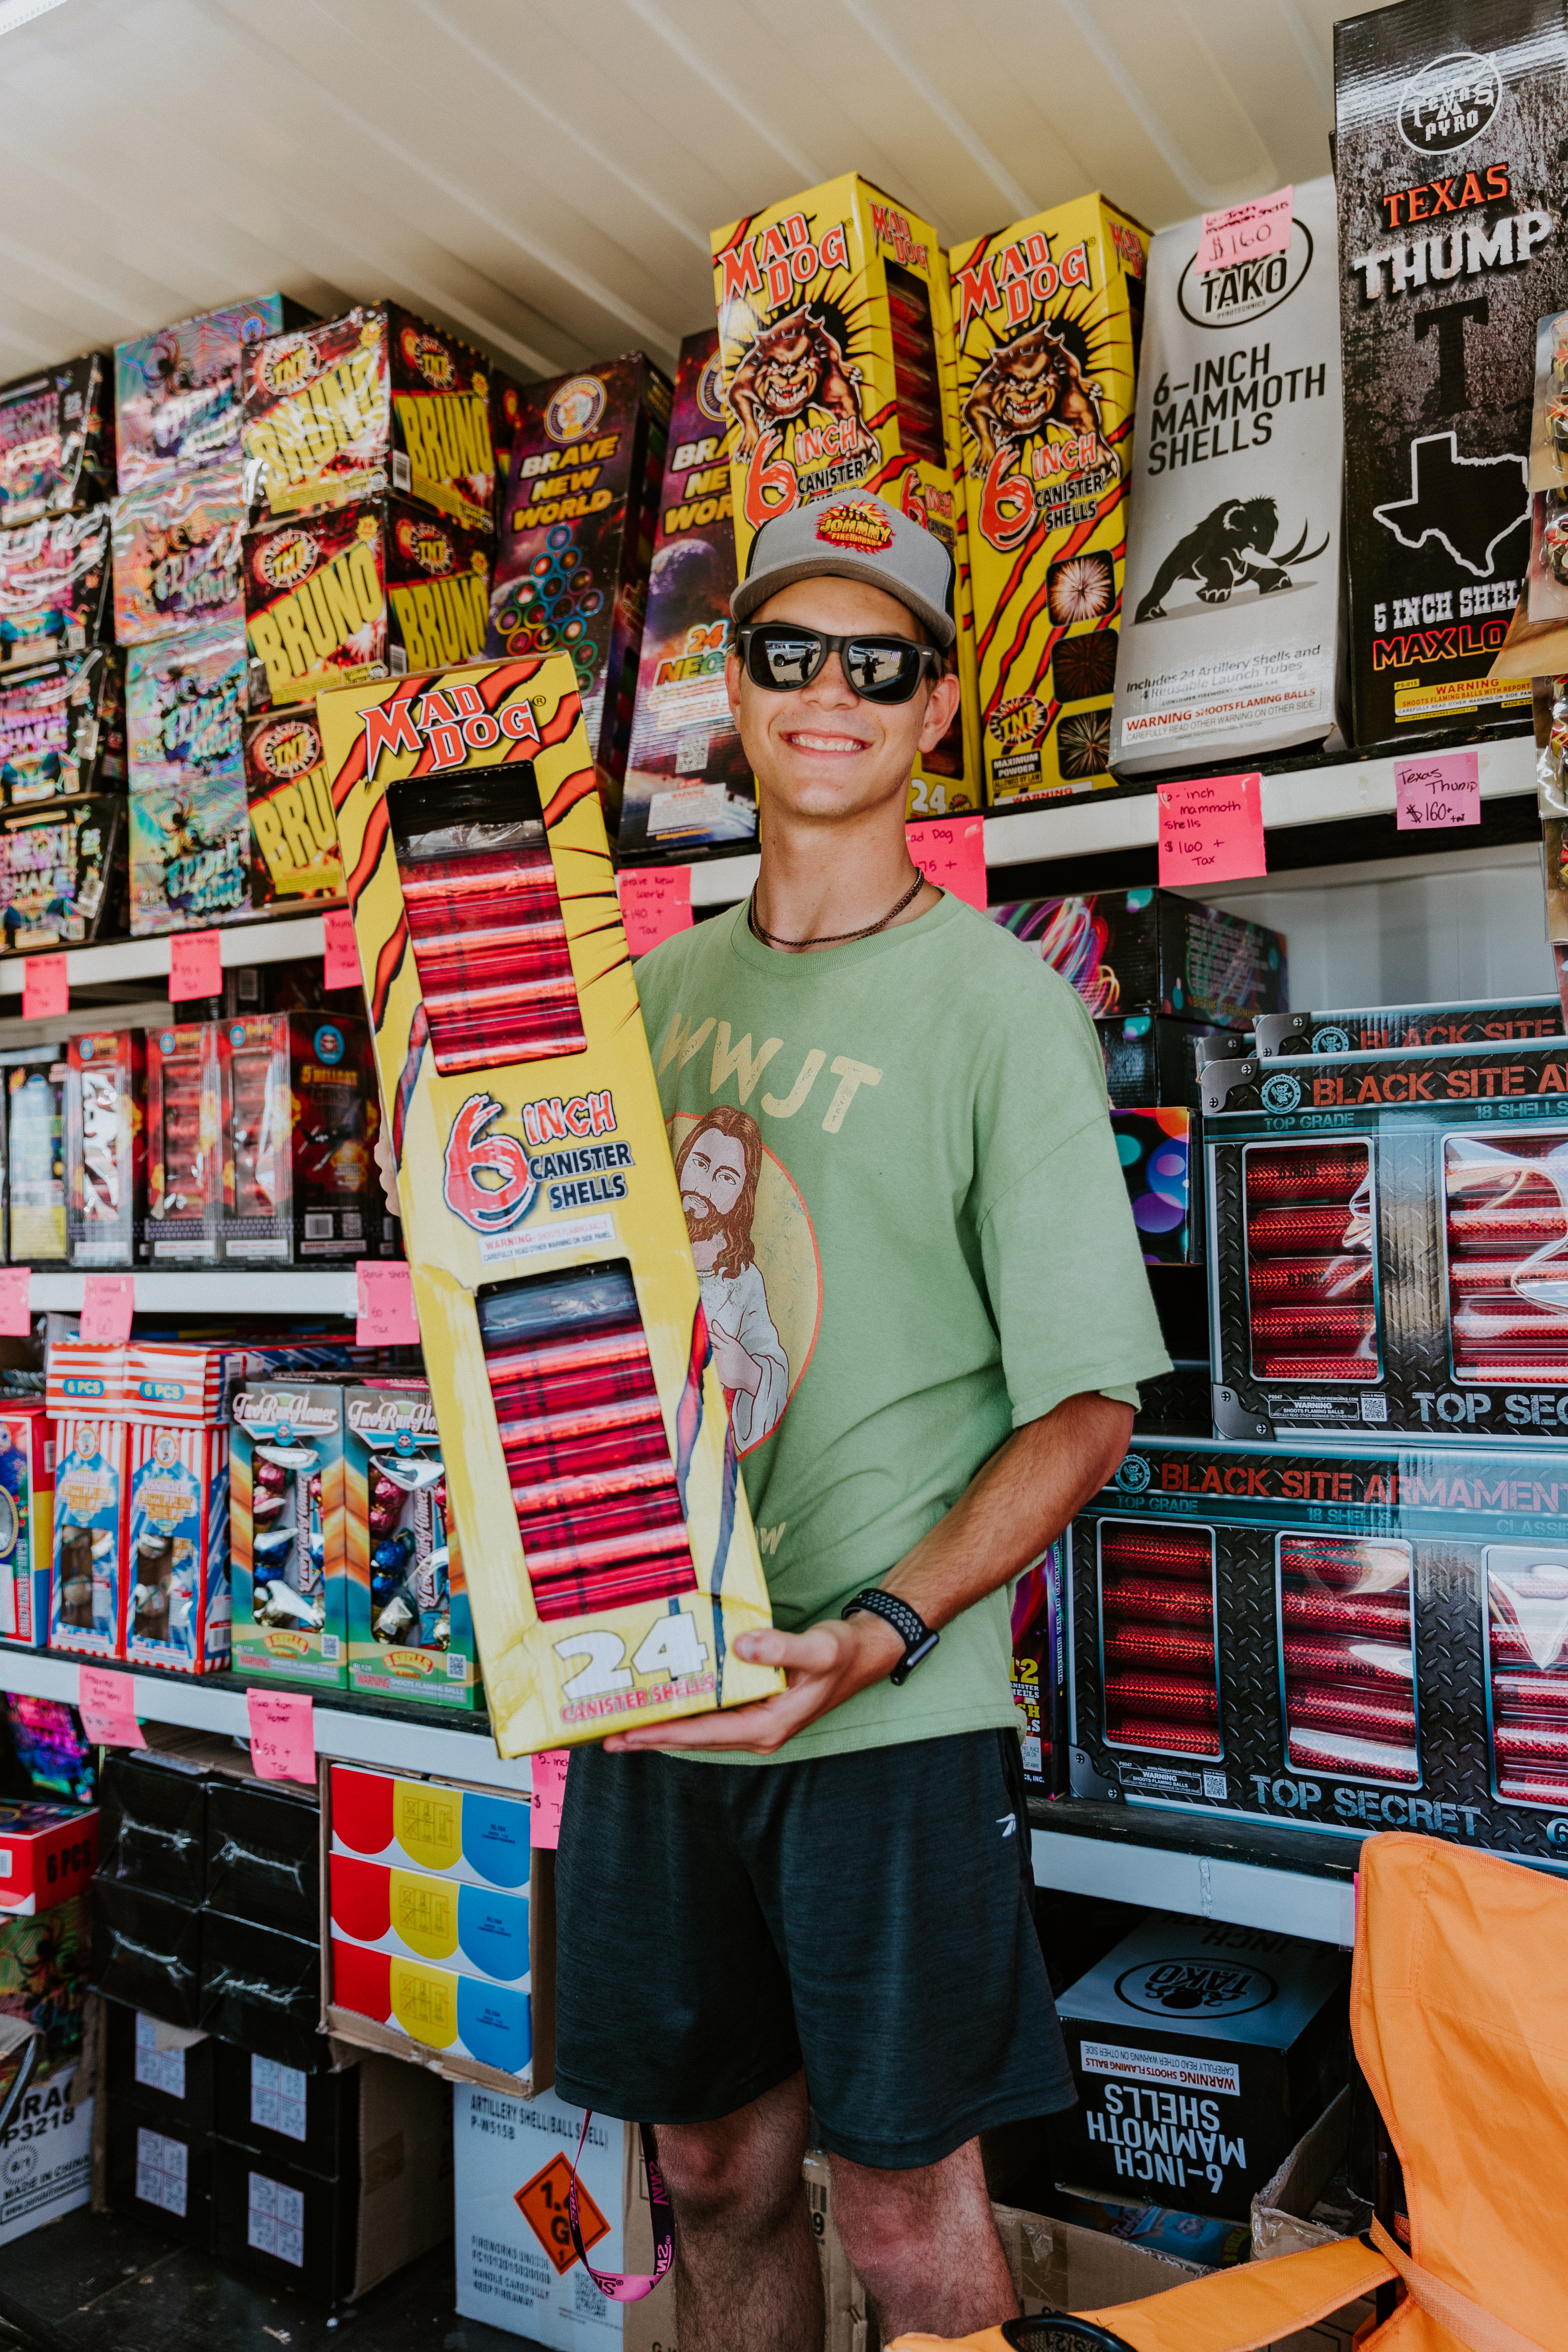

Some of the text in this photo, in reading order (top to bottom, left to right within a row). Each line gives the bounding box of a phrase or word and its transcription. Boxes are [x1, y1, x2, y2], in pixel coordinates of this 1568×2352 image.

[1384, 164, 1508, 227] TEXAS
[868, 199, 911, 255] MAD
[718, 211, 809, 336] MAD
[765, 223, 851, 313] DOG
[892, 234, 930, 279] DOG
[1353, 211, 1553, 299] THUMP
[956, 231, 1050, 355] MAD
[1004, 241, 1090, 331] DOG
[1201, 257, 1287, 313] TAKO
[272, 346, 307, 387] TNT
[422, 351, 449, 374] TNT
[1152, 343, 1271, 406] 6-INCH
[1150, 363, 1326, 442] MAMMOTH
[244, 349, 382, 515] BRUNO
[393, 395, 493, 483] BRUNO
[793, 414, 859, 467] INCH
[1147, 412, 1273, 476] SHELLS
[518, 432, 621, 479] BRAVE
[1032, 432, 1097, 481] INCH
[529, 464, 602, 503] NEW
[745, 430, 797, 531] 6
[795, 457, 867, 498] CANISTER
[1032, 472, 1105, 511] CANISTER
[512, 488, 614, 533] WORLD
[981, 444, 1037, 551] 6
[1044, 498, 1099, 533] SHELLS
[819, 518, 892, 542] JOHNNY
[831, 533, 877, 546] FIREWORKS
[271, 539, 304, 578] TNT
[418, 540, 445, 564] TNT
[246, 543, 384, 706] BRUNO
[1374, 590, 1454, 632] 5 INCH
[687, 623, 726, 653] 24
[1373, 628, 1458, 671] MAX
[1126, 645, 1321, 693] Includes 24 Artillery Shells and
[1151, 661, 1303, 698] Reusable Launch Tubes
[1436, 679, 1499, 695] WARNING
[1127, 710, 1192, 732] WARNING
[1195, 703, 1234, 718] SHOOTS
[1235, 693, 1282, 710] FLAMING
[1283, 688, 1316, 701] BALLS
[1403, 698, 1429, 707] SHOOTS
[1430, 693, 1460, 703] FLAMING
[1462, 690, 1483, 698] BALLS
[356, 683, 487, 782] MAD
[423, 698, 541, 772] DOG
[1000, 702, 1033, 739] TNT
[1126, 728, 1167, 741] CAREFULLY
[1168, 723, 1188, 734] READ
[1190, 717, 1216, 730] OTHER
[1217, 712, 1253, 725] WARNING
[1255, 709, 1266, 718] ON
[1267, 704, 1295, 716] OTHER
[272, 732, 306, 767] TNT
[993, 752, 1039, 769] MAXIMUM
[994, 773, 1042, 789] ALLOWED BY LAW
[998, 763, 1035, 779] POWDER
[1397, 768, 1442, 786] Texas
[1425, 781, 1478, 794] Thump
[911, 778, 946, 815] 24
[1013, 787, 1074, 803] WARNING
[1192, 855, 1216, 866] Tax
[1313, 1066, 1526, 1106] BLACK SITE
[522, 1089, 618, 1146] INCH
[1264, 1113, 1354, 1130] TOP GRADE
[1475, 1101, 1568, 1119] 18 SHELLS
[443, 1091, 536, 1234] 6
[527, 1140, 635, 1183] CANISTER
[547, 1172, 629, 1212] SHELLS
[77, 1380, 101, 1393] PCS
[144, 1383, 181, 1399] 6 PCS
[1412, 1391, 1491, 1424] TOP
[1161, 1463, 1353, 1501] BLACK SITE
[1116, 1495, 1198, 1513] TOP GRADE
[1307, 1507, 1391, 1527] 18 SHELLS
[239, 1656, 270, 1669] WARNING
[392, 1651, 433, 1675] SHELLS
[552, 1611, 709, 1701] 24
[357, 1673, 390, 1688] WARNING
[390, 1678, 464, 1695] SHOOTS FLAMING BALLS
[561, 1674, 717, 1723] CANISTER SHELLS
[1142, 1771, 1177, 1781] WARNING
[1249, 1774, 1481, 1836] TOP SECRET
[1546, 1818, 1568, 1847] 6
[46, 1854, 56, 1883] 6
[1147, 1964, 1253, 1995] TAKO
[1085, 2057, 1237, 2091] WARNING SHOOTS FLAMING BALLS
[1099, 2046, 1234, 2076] CAREFULLY READ OTHER WARNING ON OTHER
[471, 2096, 517, 2116] ARTILLERY
[1104, 2083, 1220, 2132] SHELLS
[1086, 2110, 1247, 2169] MAMMOTH
[1114, 2146, 1223, 2194] 6-INCH
[558, 2250, 564, 2262] 1
